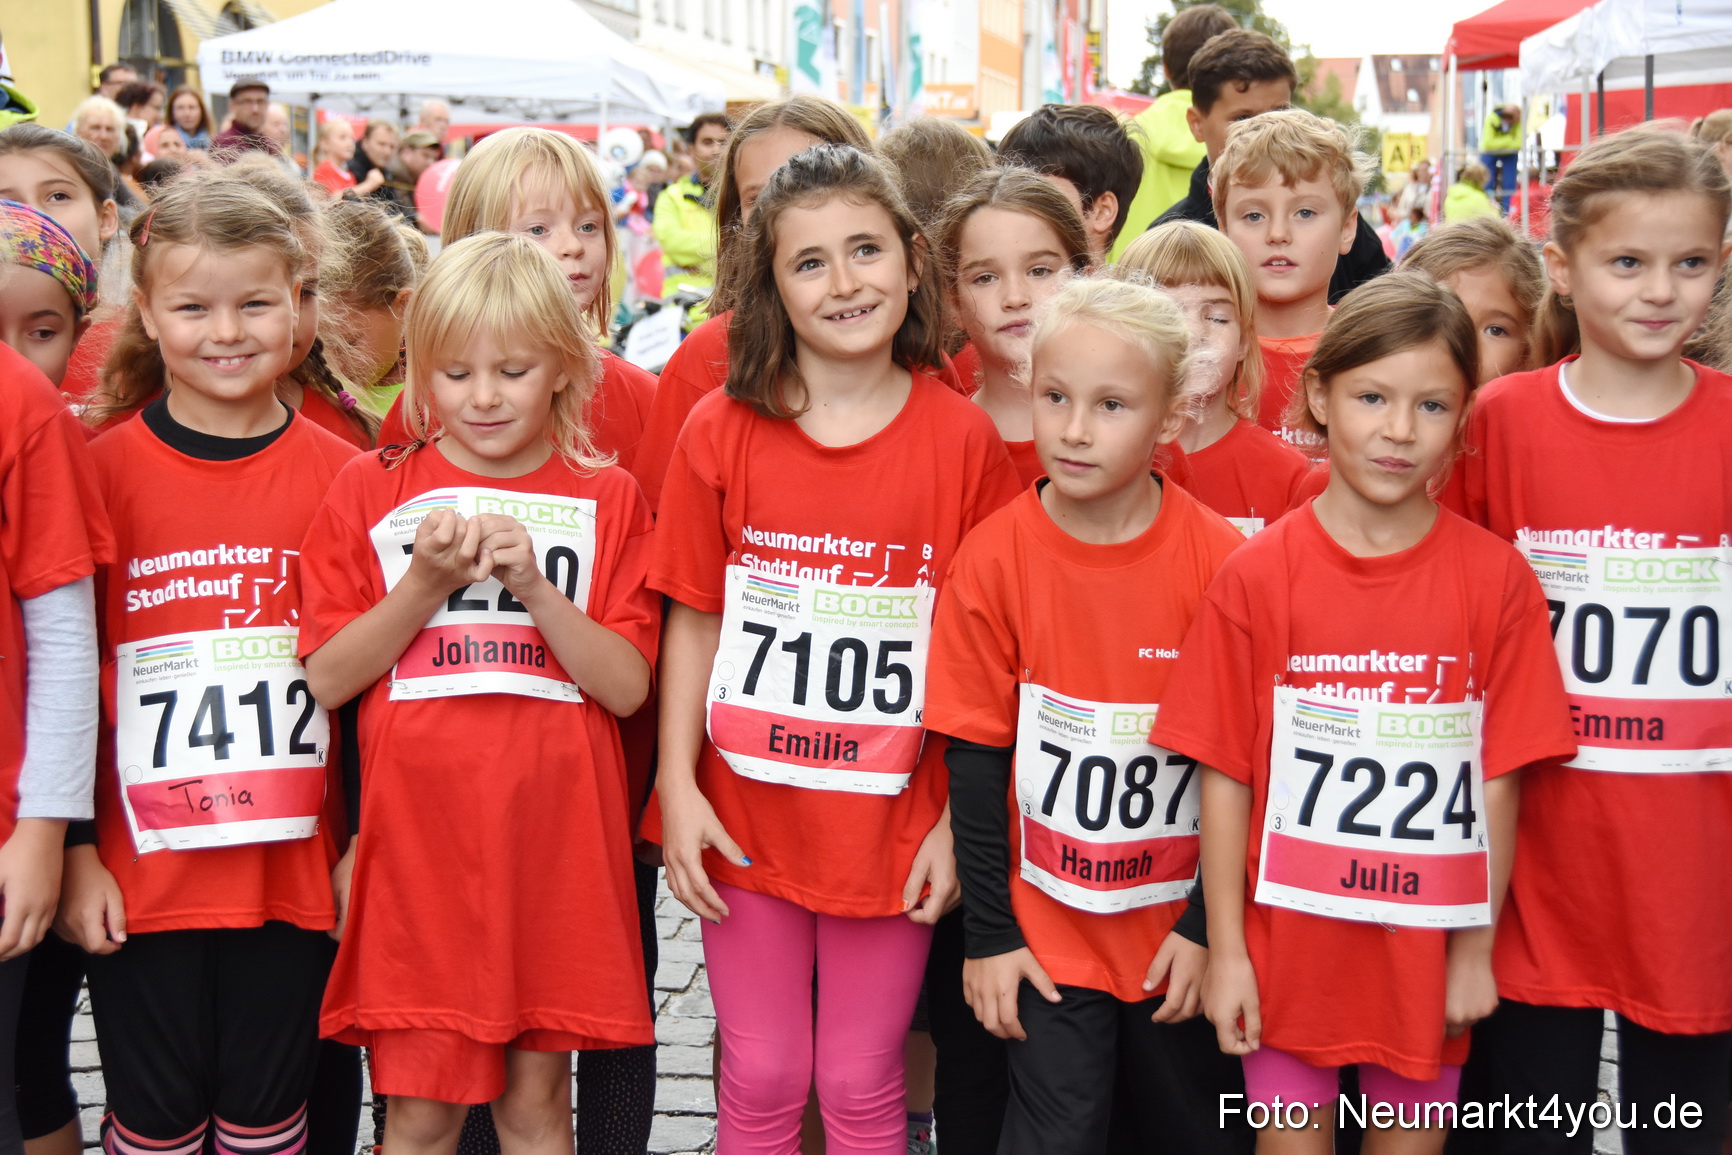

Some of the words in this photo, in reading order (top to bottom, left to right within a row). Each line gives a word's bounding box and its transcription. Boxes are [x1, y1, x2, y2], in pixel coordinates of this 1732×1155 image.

[221, 50, 272, 65] BMW
[279, 50, 431, 66] ConnectedDrive
[1389, 145, 1405, 164] A
[475, 495, 582, 530] BOCK
[548, 528, 582, 538] concepts
[742, 525, 877, 558] Neumarkter
[1515, 525, 1665, 550] Neumarkter
[127, 544, 273, 580] Neumarkter
[741, 553, 844, 585] Stadtlauf
[1604, 557, 1721, 583] BOCK
[1533, 567, 1590, 584] euerMarkt
[126, 573, 244, 612] Stadtlauf
[1603, 584, 1641, 594] inspired
[1643, 584, 1654, 594] by
[1656, 585, 1683, 593] smart
[741, 591, 801, 613] NeuerMarkt
[813, 589, 918, 620] BOCK
[811, 614, 845, 626] inspired
[846, 618, 857, 627] by
[859, 620, 883, 628] smart
[885, 621, 919, 629] concepts
[432, 634, 546, 669] Johanna
[1138, 648, 1153, 658] FC
[133, 658, 199, 677] NeuerMarkt
[214, 664, 250, 672] inspired
[251, 662, 262, 670] by
[264, 661, 287, 669] smart
[742, 620, 913, 714] 7105
[136, 677, 157, 685] einkaufen
[1724, 680, 1732, 694] K
[718, 687, 727, 700] 3
[140, 678, 317, 769] 7412
[915, 710, 922, 723] K
[1037, 710, 1097, 737] NeuerMarkt
[1291, 715, 1361, 739] NeuerMarkt
[1376, 711, 1473, 739] BOCK
[1569, 704, 1664, 741] Emma
[768, 723, 859, 763] Emilia
[1110, 737, 1141, 746] inspired
[1375, 739, 1412, 749] inspired
[1414, 739, 1425, 749] by
[1427, 740, 1450, 748] smart
[318, 750, 324, 764] K
[168, 780, 254, 814] Tonia
[1039, 739, 1199, 832] 7087
[1294, 746, 1476, 841] 7224
[1024, 803, 1032, 815] 3
[1191, 819, 1199, 831] K
[1274, 816, 1282, 830] 3
[1477, 834, 1484, 848] K
[1060, 843, 1154, 883] Hannah
[1340, 859, 1420, 896] Julia
